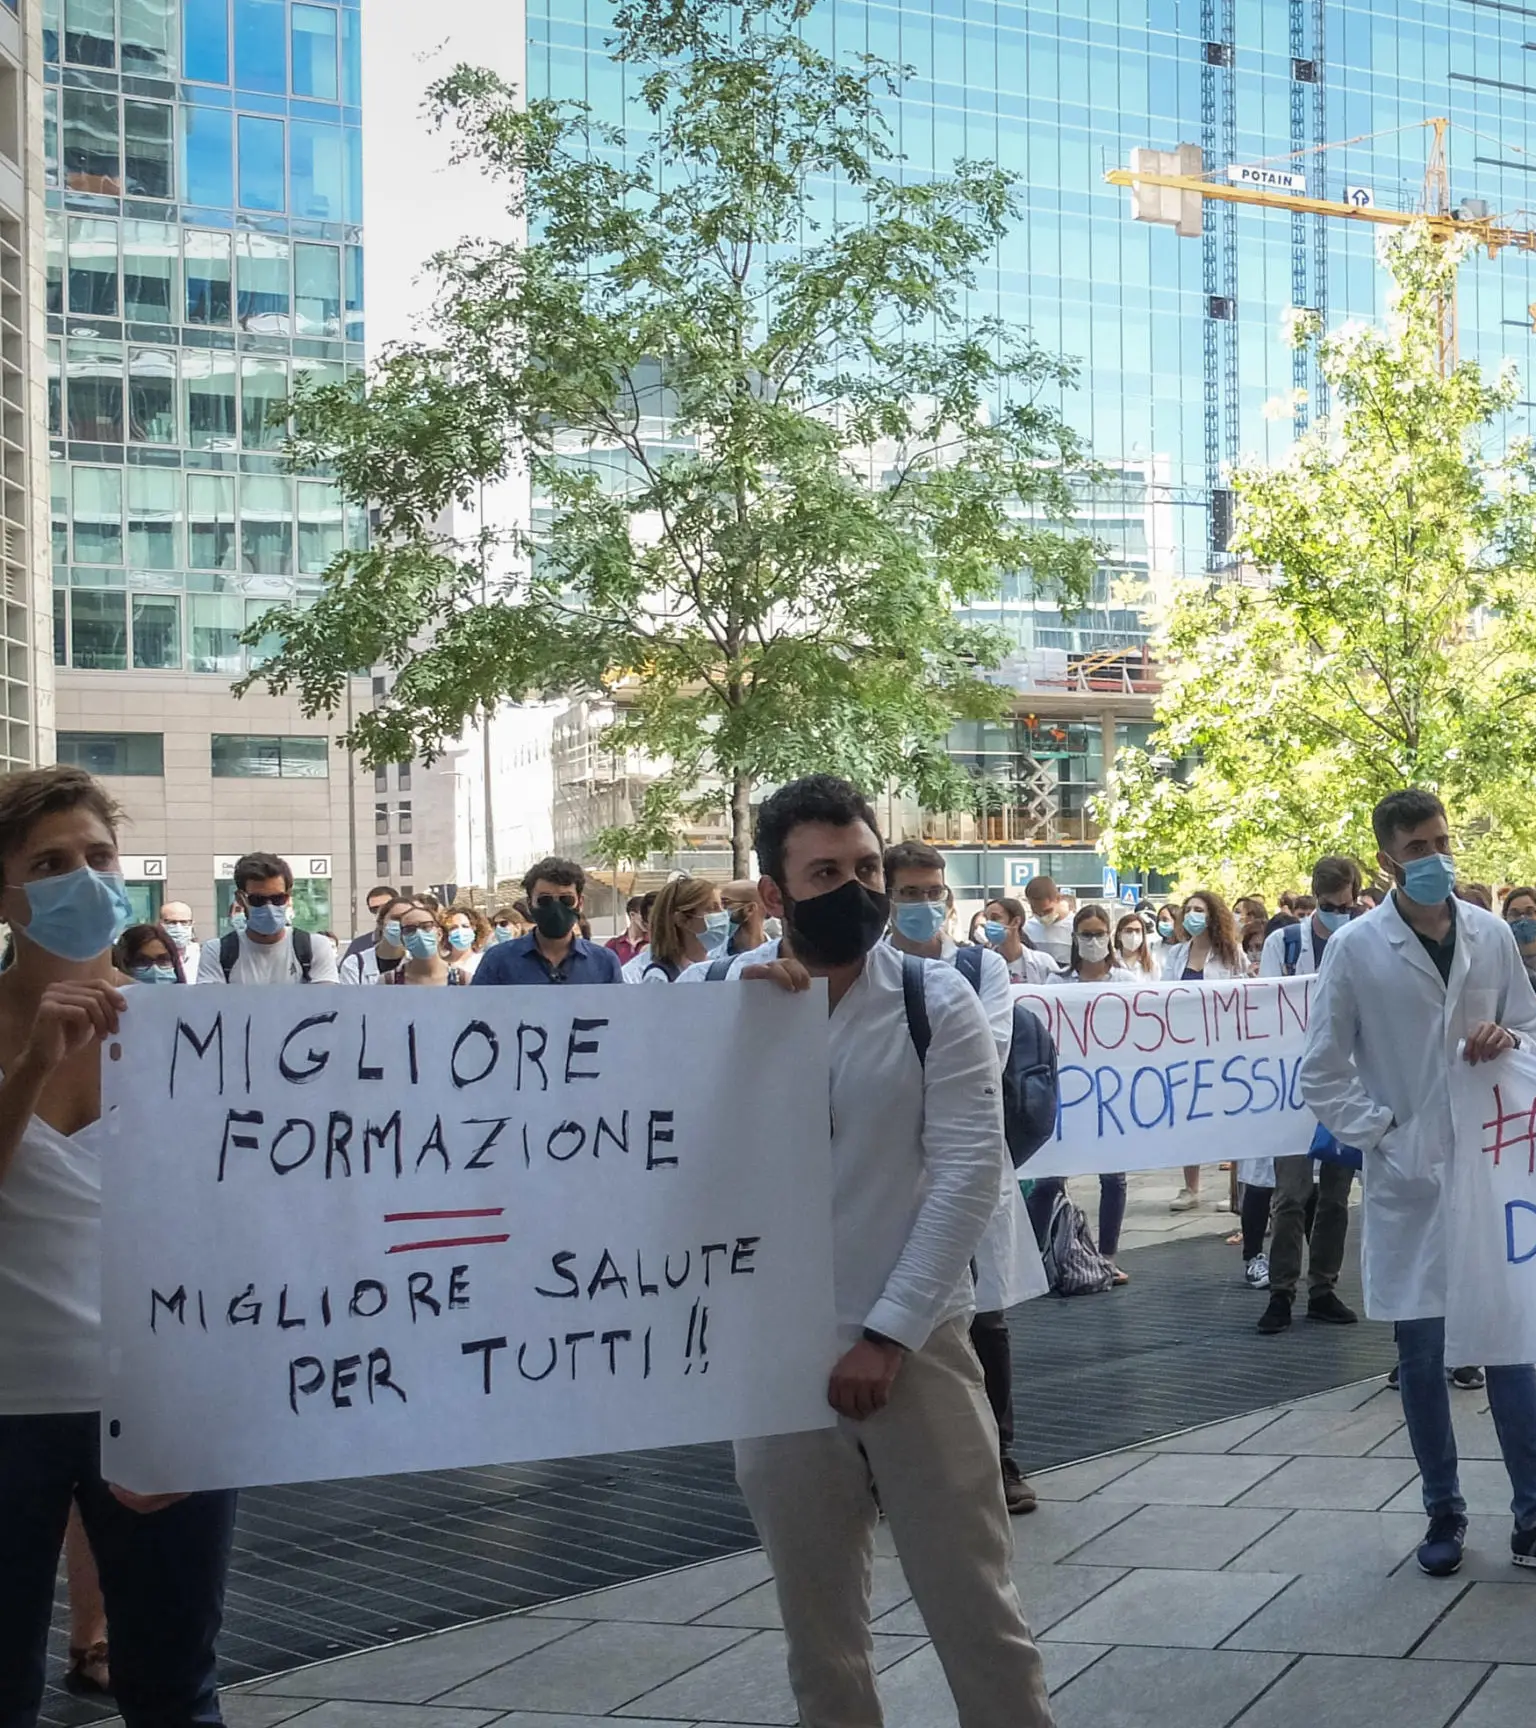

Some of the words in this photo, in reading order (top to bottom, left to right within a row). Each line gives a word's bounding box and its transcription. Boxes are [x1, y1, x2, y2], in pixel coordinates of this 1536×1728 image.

[1242, 169, 1293, 186] POTAIN
[1015, 865, 1029, 884] P
[168, 1010, 610, 1099] MIGLIORE
[217, 1108, 680, 1183] FORMAZIONE
[150, 1264, 470, 1333] MIGLIORE
[534, 1236, 761, 1301] SALUTE
[289, 1346, 408, 1415] PER
